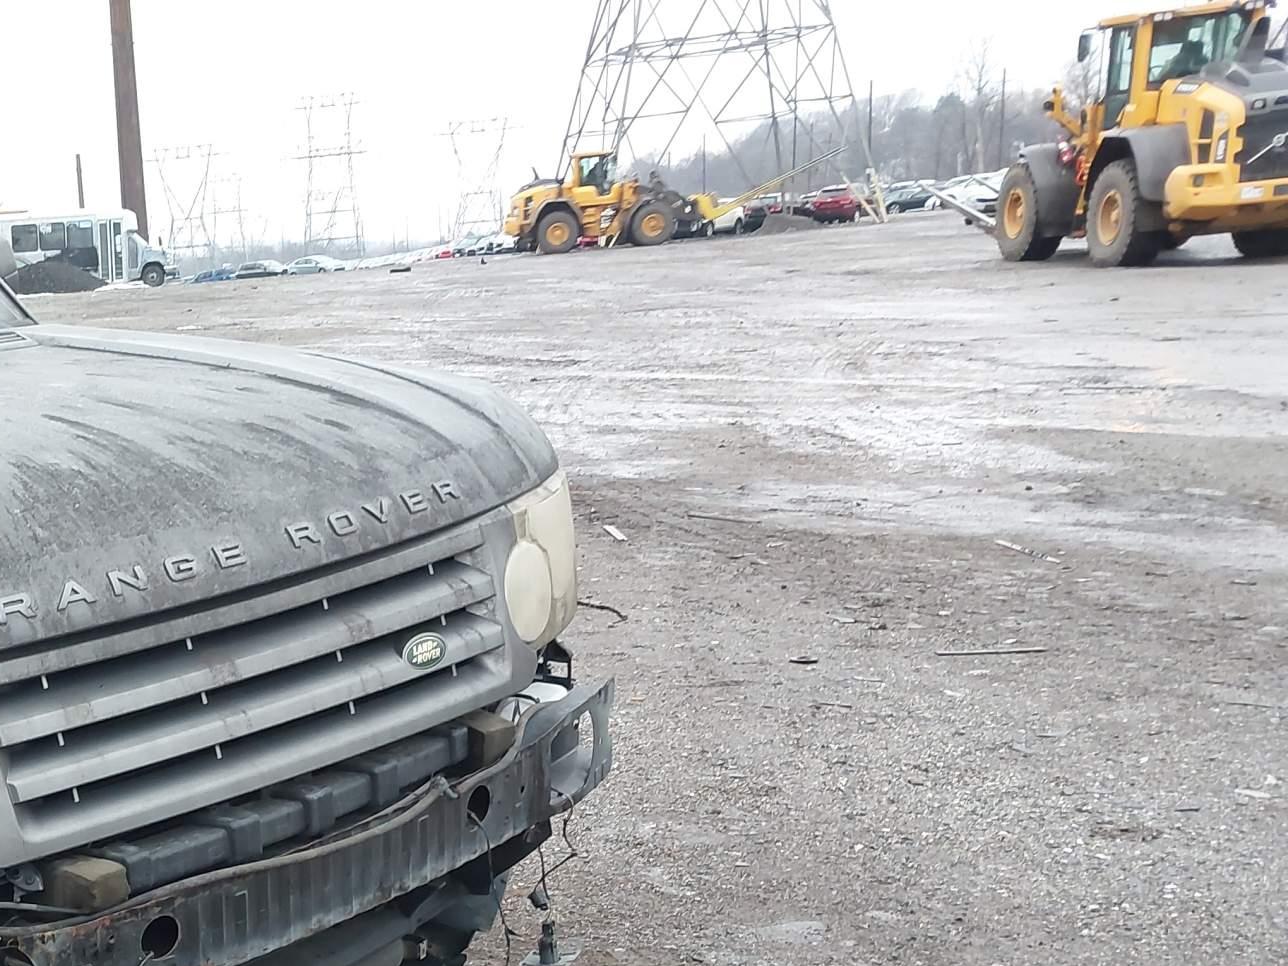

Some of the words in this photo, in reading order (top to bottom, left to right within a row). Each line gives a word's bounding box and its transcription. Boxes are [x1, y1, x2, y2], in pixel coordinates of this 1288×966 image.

[284, 479, 462, 550] ROVER
[412, 640, 434, 657] LAND
[417, 647, 441, 665] ROVER
